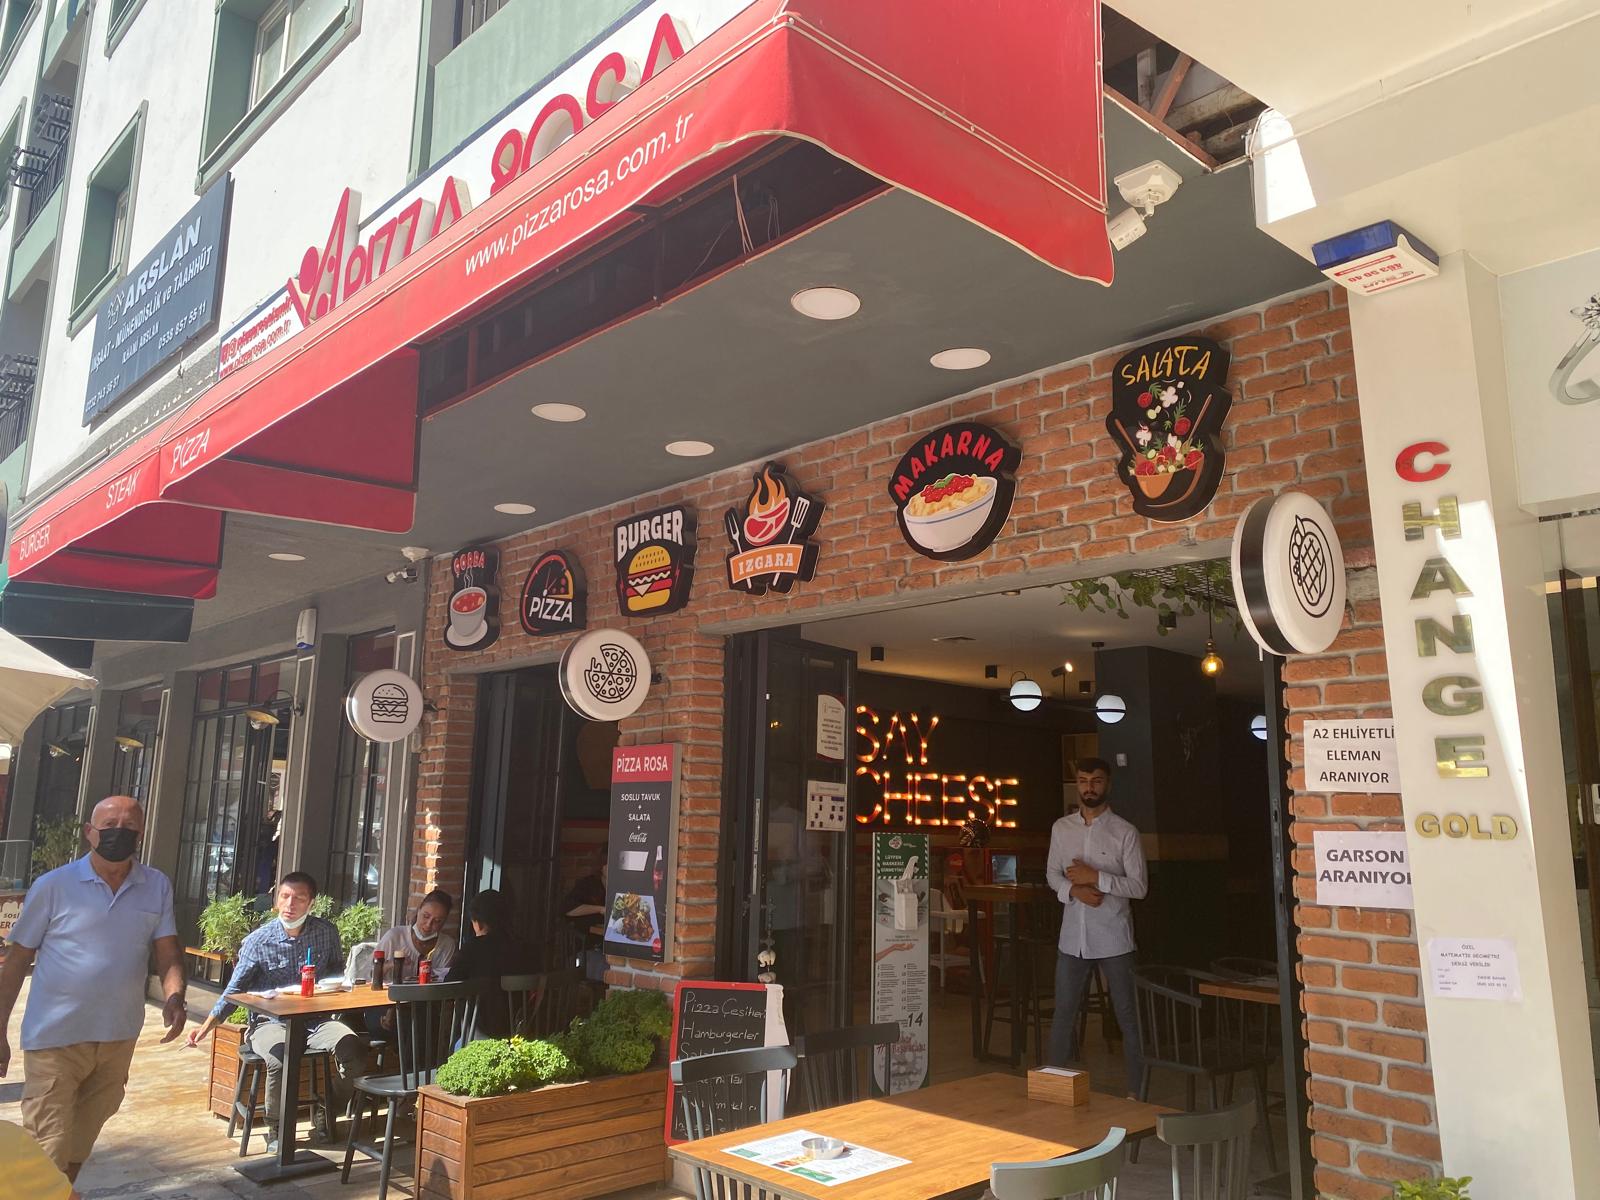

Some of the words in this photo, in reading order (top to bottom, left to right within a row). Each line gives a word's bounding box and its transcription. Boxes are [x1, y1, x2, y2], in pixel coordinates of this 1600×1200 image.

[465, 111, 694, 277] www.pizzarosa.com.tr
[122, 215, 201, 316] ARSLAN
[115, 291, 161, 349] MÜHENDİSLİK
[162, 285, 172, 304] ve
[173, 245, 213, 294] TAAHHÜT
[1121, 345, 1211, 386] SALATA
[894, 430, 1004, 501] MAKARNA
[106, 469, 142, 509] STEAK
[19, 524, 50, 561] BURGER
[617, 509, 684, 562] BURGER
[738, 552, 794, 576] IZGARA
[1395, 441, 1489, 779] CHANGE
[856, 705, 940, 765] SAY
[1312, 728, 1329, 739] A2
[1332, 725, 1395, 740] EHLİYETLİ
[616, 753, 641, 773] PİZZA
[643, 755, 668, 772] ROSA
[1326, 750, 1381, 761] ELEMAN
[1319, 771, 1389, 784] ARANIYOR
[621, 793, 640, 801] SOSLU
[641, 793, 661, 801] TAVUK
[856, 766, 1019, 827] CHEESE
[628, 813, 651, 821] SALATA
[1415, 811, 1518, 841] GOLD
[1326, 849, 1404, 864] GARSON
[683, 991, 719, 1013] Pizza
[681, 1021, 760, 1044] Hamburgerler
[908, 1013, 924, 1027] 14
